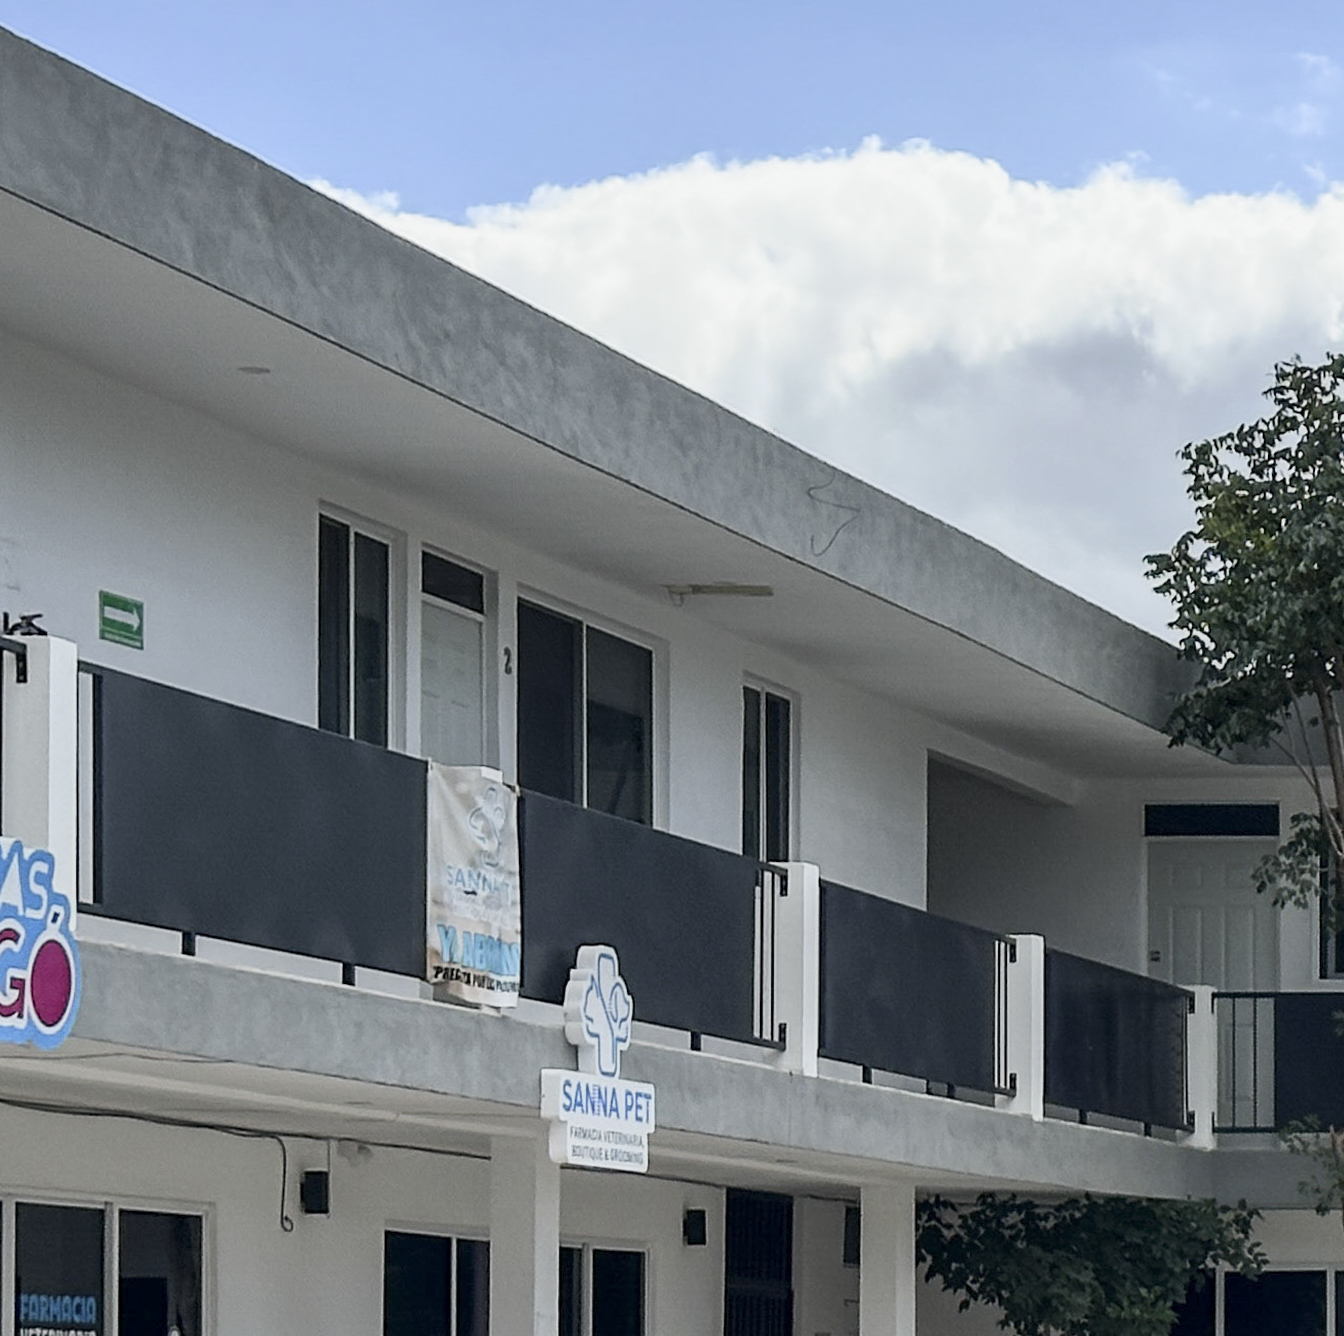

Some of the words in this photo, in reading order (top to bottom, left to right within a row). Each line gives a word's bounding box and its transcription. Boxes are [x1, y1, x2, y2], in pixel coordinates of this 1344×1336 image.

[503, 646, 512, 675] 2
[562, 1079, 620, 1120] SANNA
[625, 1089, 653, 1124] PET
[20, 1293, 96, 1325] FARMACIA
